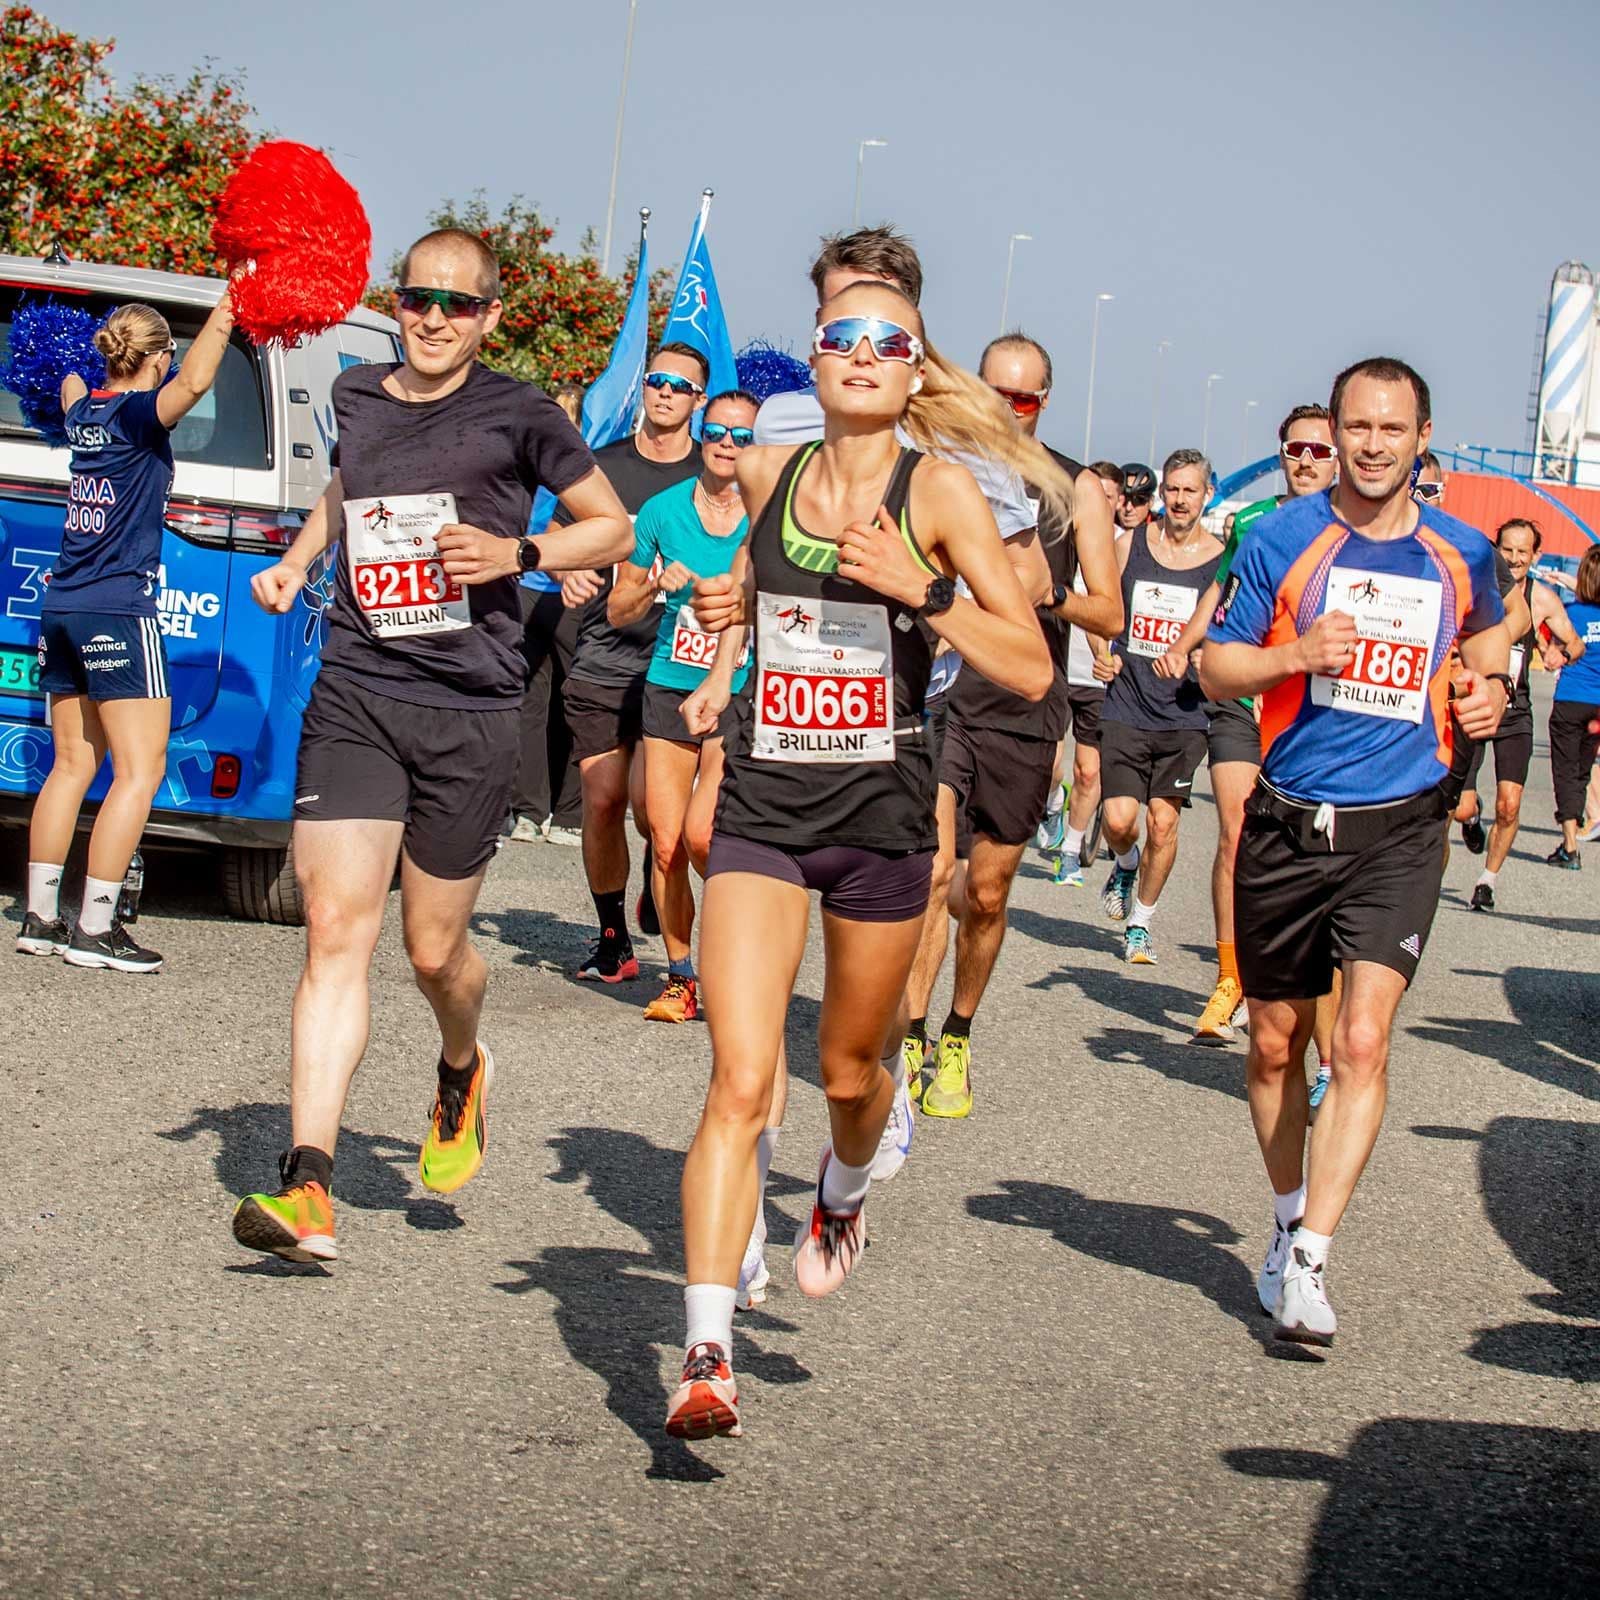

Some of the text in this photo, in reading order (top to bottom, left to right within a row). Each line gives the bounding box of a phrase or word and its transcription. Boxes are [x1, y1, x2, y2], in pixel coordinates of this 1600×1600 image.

[71, 474, 116, 504] EMA
[65, 503, 105, 534] 000
[356, 554, 393, 564] BRILLIANT
[357, 561, 447, 608] 3213
[156, 611, 198, 639] SEL
[371, 606, 448, 628] BRILLIANT
[1133, 615, 1181, 646] 3146
[81, 641, 128, 653] SOLVINGE
[676, 631, 719, 664] 292
[766, 661, 882, 676] BRILLIANT HALVMARATON
[1351, 639, 1414, 689] 186
[764, 674, 869, 727] 3066
[873, 683, 885, 722] PULJE 2
[1330, 681, 1406, 708] BRILLIANT
[776, 731, 869, 751] BRILLIANT
